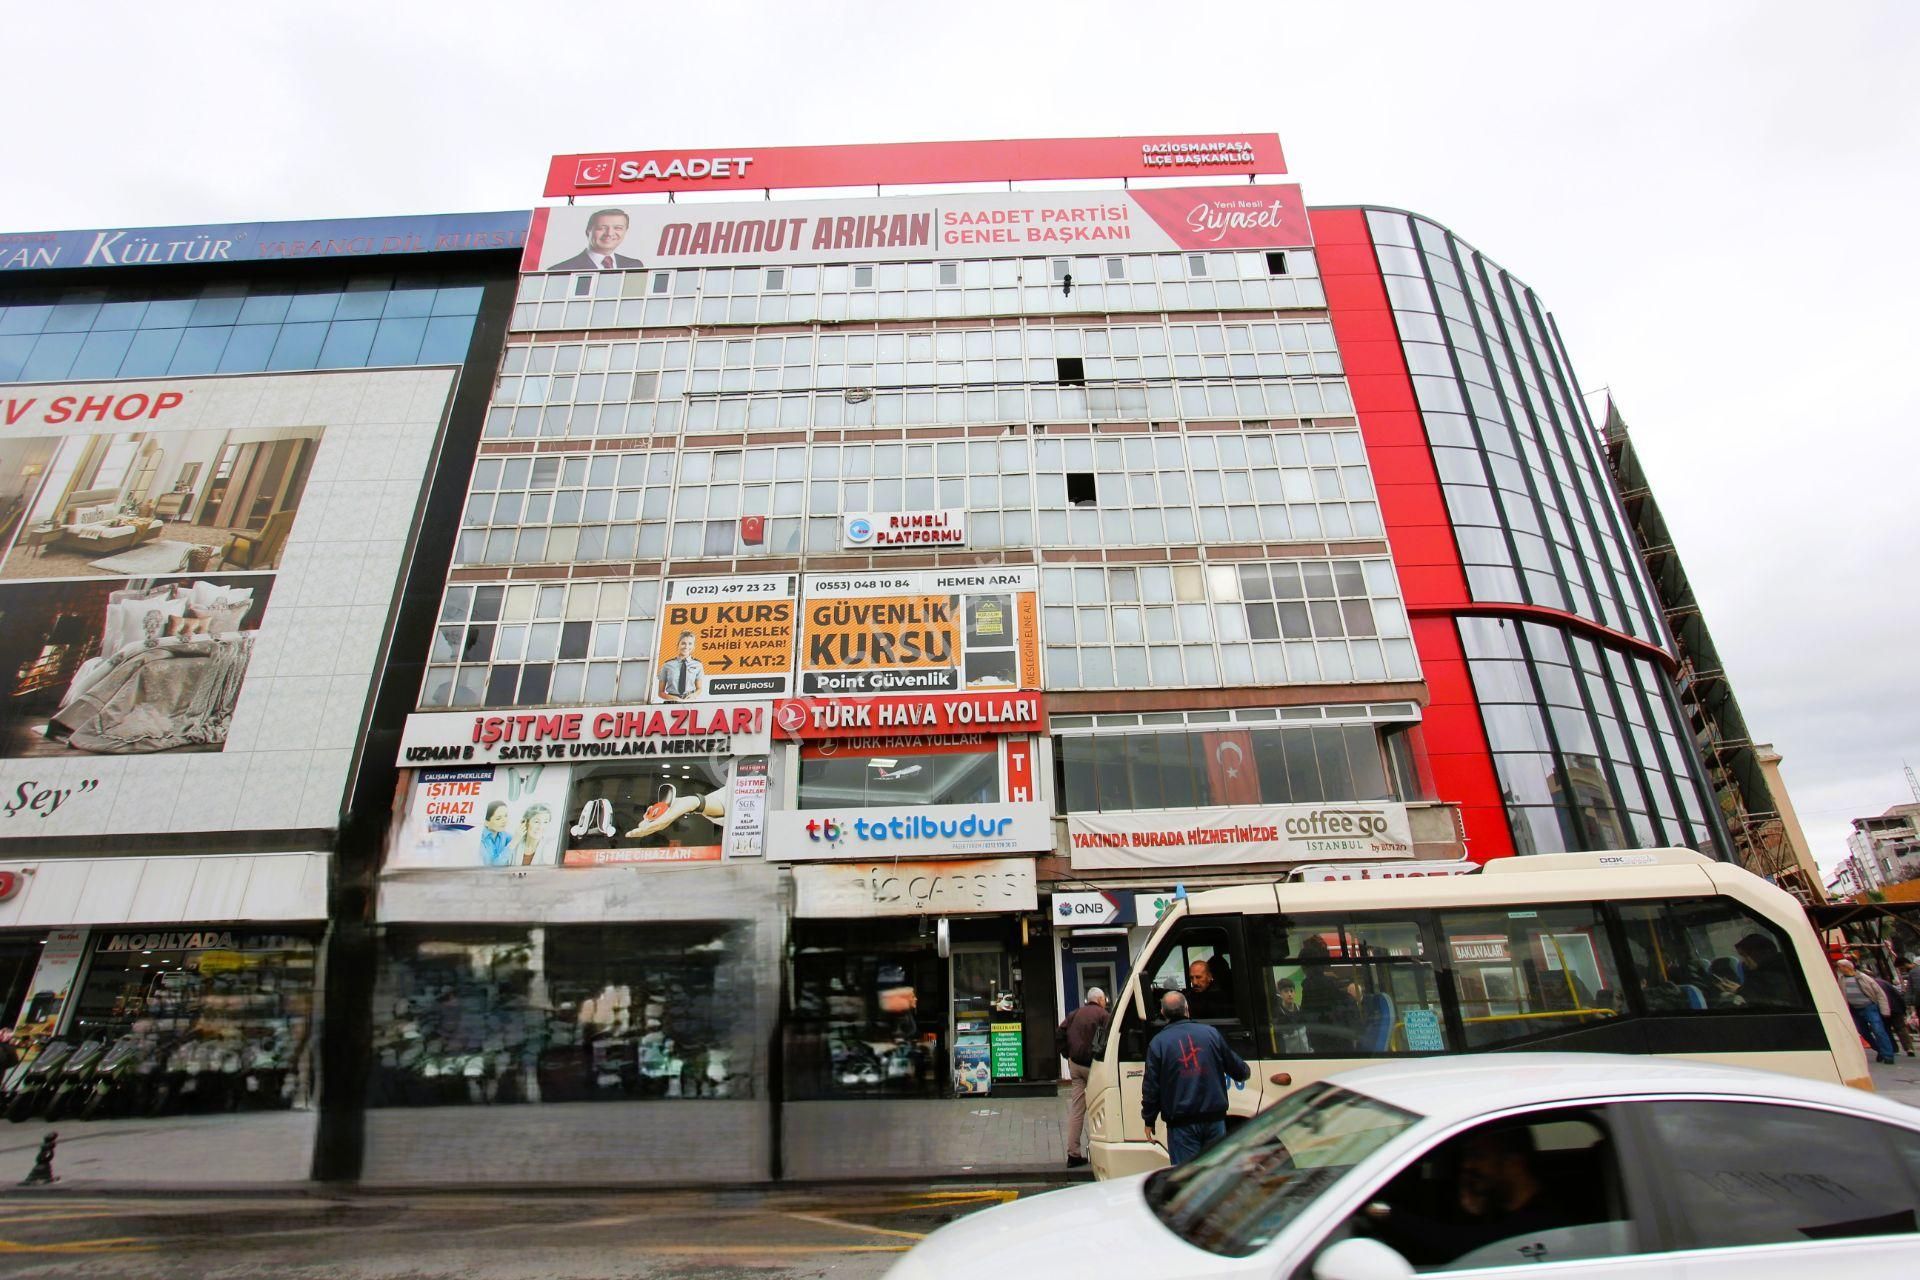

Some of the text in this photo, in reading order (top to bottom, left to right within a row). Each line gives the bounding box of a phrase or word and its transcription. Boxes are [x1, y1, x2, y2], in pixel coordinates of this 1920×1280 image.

[1142, 141, 1252, 154] GAZİOSMANPAŞA
[1143, 152, 1255, 166] İLÇE BAŞKANLIĞI
[618, 157, 753, 181] SAADET
[1214, 200, 1263, 209] Yeni Nesil
[944, 203, 1129, 226] SAADET PARTİSİ
[1186, 200, 1283, 242] Siyaset
[657, 212, 931, 257] MAHMUT ARIKAN
[944, 225, 1132, 245] GENEL BAŞKANI
[0, 246, 61, 268] AN
[82, 231, 232, 266] KÜLTÜR
[0, 392, 184, 425] V SHOP
[890, 511, 947, 528] RUMELİ
[877, 529, 962, 544] PLATFORMU
[686, 583, 776, 596] (0212) 497 23 23
[816, 579, 910, 591] (0553) 048 10 84
[937, 575, 1021, 587] HEMEN ARA!
[670, 604, 789, 625] BU KURS
[813, 598, 949, 626] GÜVENLİK
[701, 625, 790, 639] SİZİ MESLEK
[702, 640, 786, 651] SAHİBİ YAPAR!
[810, 630, 952, 666] KURSU
[740, 654, 785, 668] KAT:2
[714, 681, 774, 691] KAYIT BÜROSU
[817, 671, 950, 689] Point Güvenlik
[810, 699, 1038, 728] TÜRK HAVA YOLLARI
[472, 708, 764, 751] İŞİTME CİHAZLARI
[406, 745, 461, 762] UZMAN
[499, 744, 543, 761] SATIŞ
[547, 743, 567, 758] VE
[661, 735, 731, 754] MERKEZİ
[886, 734, 921, 748] HAVA
[426, 782, 481, 800] İŞİTME
[426, 801, 474, 815] CİHAZI
[429, 815, 466, 824] VERİLİR
[854, 813, 1013, 841] tatilbudur
[1285, 811, 1388, 838] coffee go
[1073, 824, 1279, 849] YAKINDA BURADA HİZMETİNİZDE
[1307, 840, 1364, 851] İSTANBUL
[1075, 903, 1104, 914] QNB
[109, 931, 234, 951] MOBİLYADA
[1455, 943, 1504, 960] BAKLAVALARI
